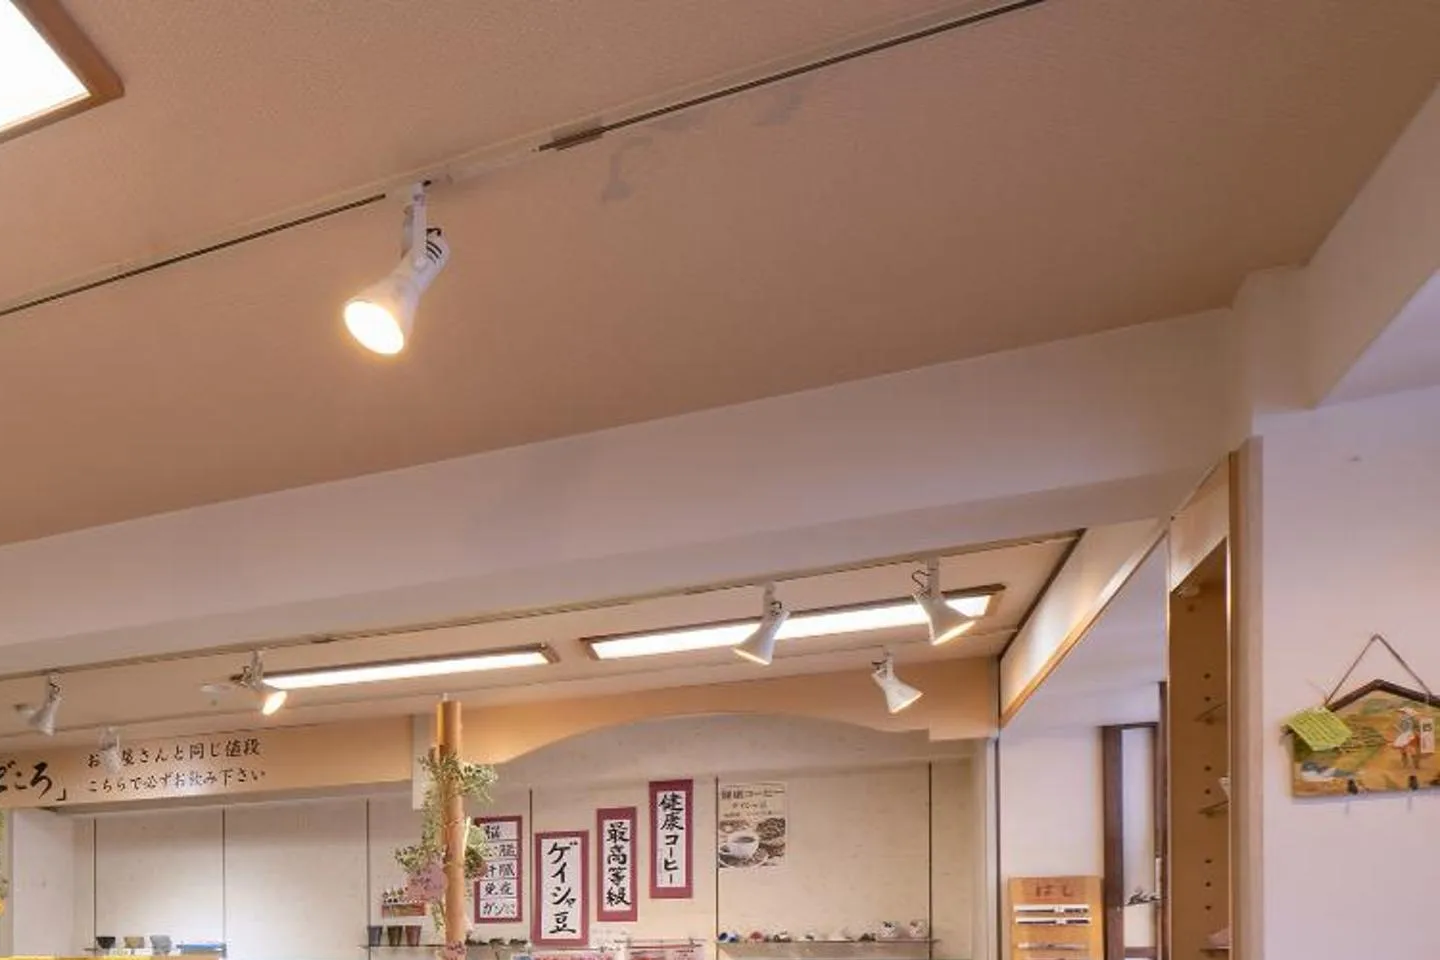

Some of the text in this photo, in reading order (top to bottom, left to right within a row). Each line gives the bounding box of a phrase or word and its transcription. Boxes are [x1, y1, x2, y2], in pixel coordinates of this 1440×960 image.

[87, 738, 260, 768] お屋さんと同じ値段
[606, 821, 632, 907] 最高等級
[658, 793, 684, 884] 健康コーヒー
[547, 840, 579, 935] ゲイシャ豆
